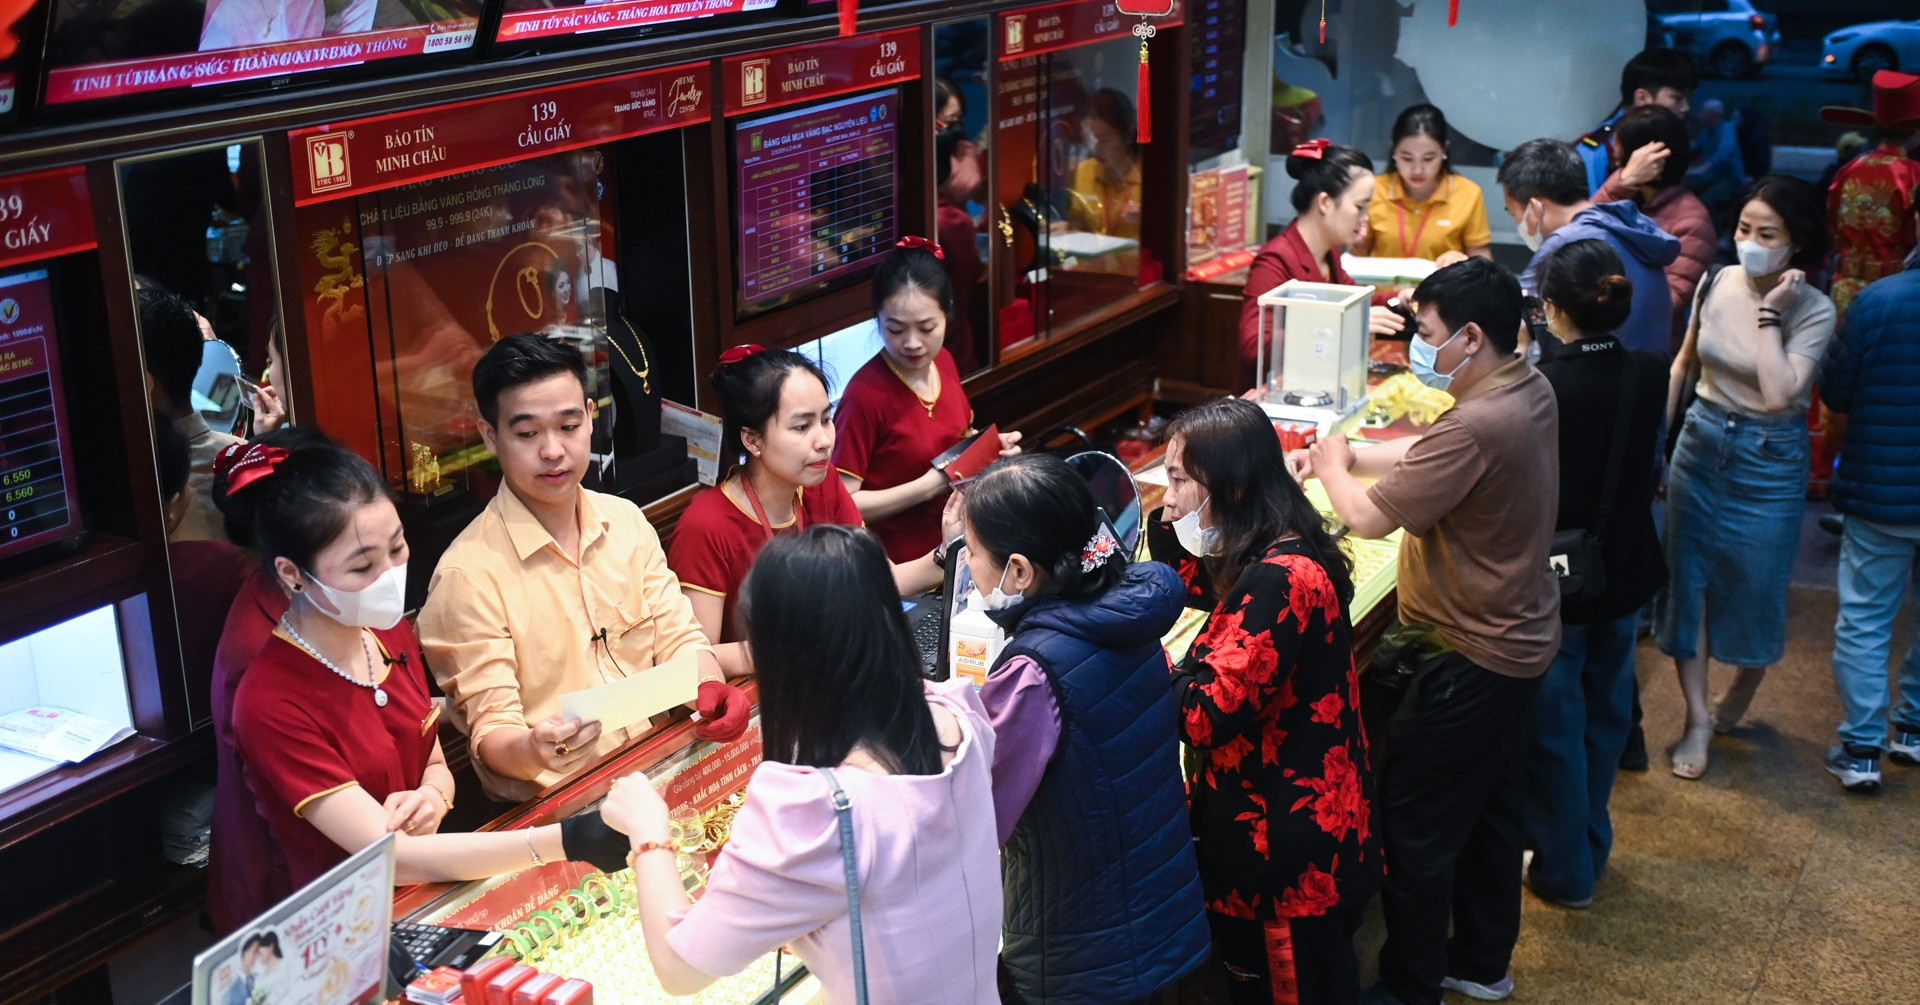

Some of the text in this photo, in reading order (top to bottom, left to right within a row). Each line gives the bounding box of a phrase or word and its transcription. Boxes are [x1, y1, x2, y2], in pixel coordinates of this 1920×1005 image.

[514, 20, 539, 33] TINH
[584, 11, 610, 24] VÀNG
[648, 5, 668, 16] HOA
[428, 34, 472, 47] 1800 58 58 99
[880, 41, 897, 58] 139
[788, 56, 819, 74] BẢO TÍN
[870, 55, 905, 78] CẦU GIẤY
[73, 75, 111, 93] TINH
[271, 78, 291, 86] SONY
[781, 73, 826, 93] MINH CHÂU
[630, 90, 645, 99] TRUNG
[532, 101, 557, 122] 139
[614, 103, 631, 113] TRANG
[642, 97, 656, 107] VÀNG
[385, 125, 435, 149] BẢO TÍN
[518, 118, 572, 147] CẦU GIẤY
[764, 136, 780, 149] BẢNG
[792, 130, 805, 142] MUA
[375, 145, 447, 174] MINH CHÂU
[317, 177, 332, 187] BTMC
[522, 175, 545, 190] LONG
[426, 217, 444, 230] 99.9
[450, 210, 470, 225] 999.9
[5, 216, 51, 249] GIẤY
[418, 244, 431, 257] KHI
[1582, 341, 1614, 352] SONY
[4, 352, 15, 361] RA
[12, 357, 34, 369] BTMC
[3, 469, 31, 485] 6.550
[6, 486, 33, 502] 6.560
[8, 510, 16, 520] 0
[11, 527, 18, 537] 0
[958, 657, 985, 667] ASIRUB
